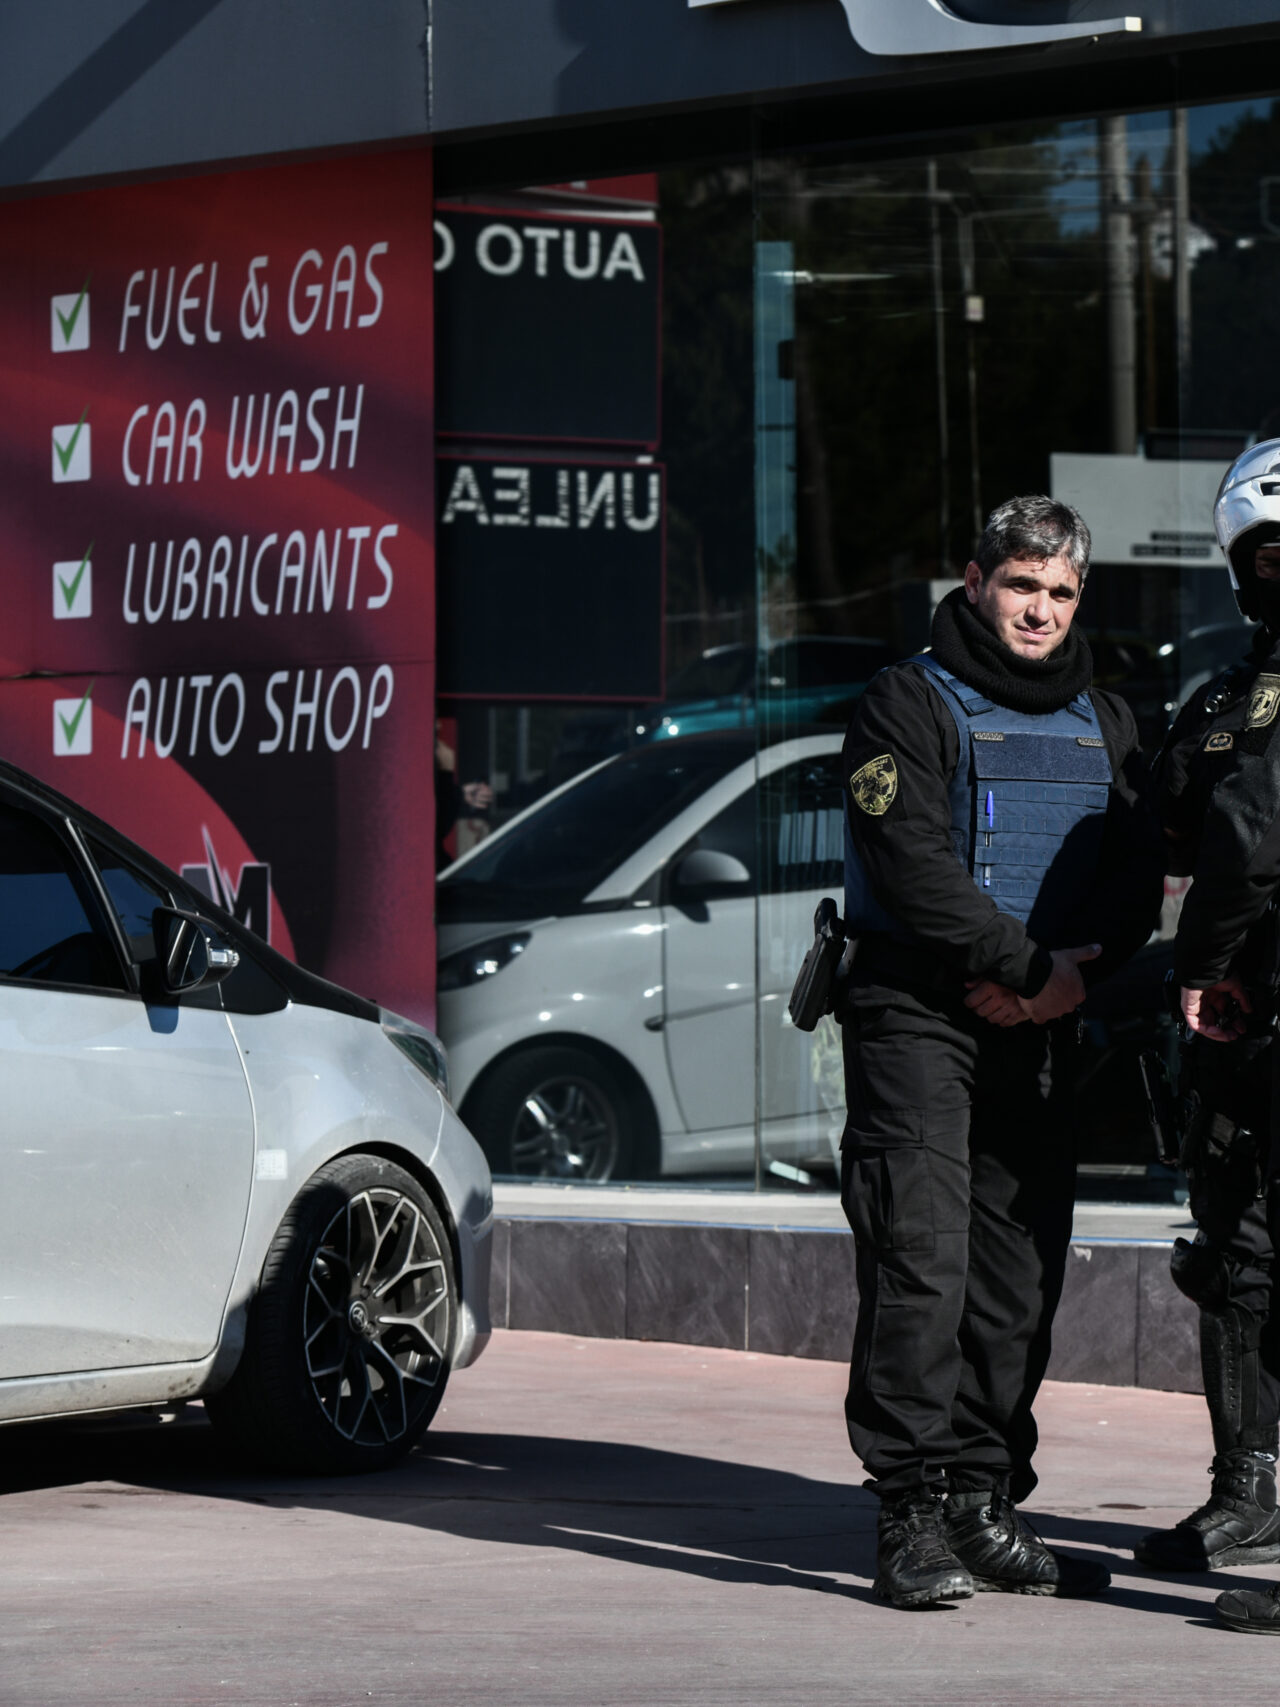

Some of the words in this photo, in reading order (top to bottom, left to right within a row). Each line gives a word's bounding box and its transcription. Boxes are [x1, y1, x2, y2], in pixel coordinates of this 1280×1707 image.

[119, 261, 221, 352] FUEL
[239, 256, 269, 341] &
[288, 242, 388, 335] GAS
[122, 398, 206, 486] CAR
[225, 384, 364, 478] WASH
[123, 524, 398, 624] LUBRICANTS
[121, 671, 246, 759] AUTO
[259, 664, 394, 754] SHOP
